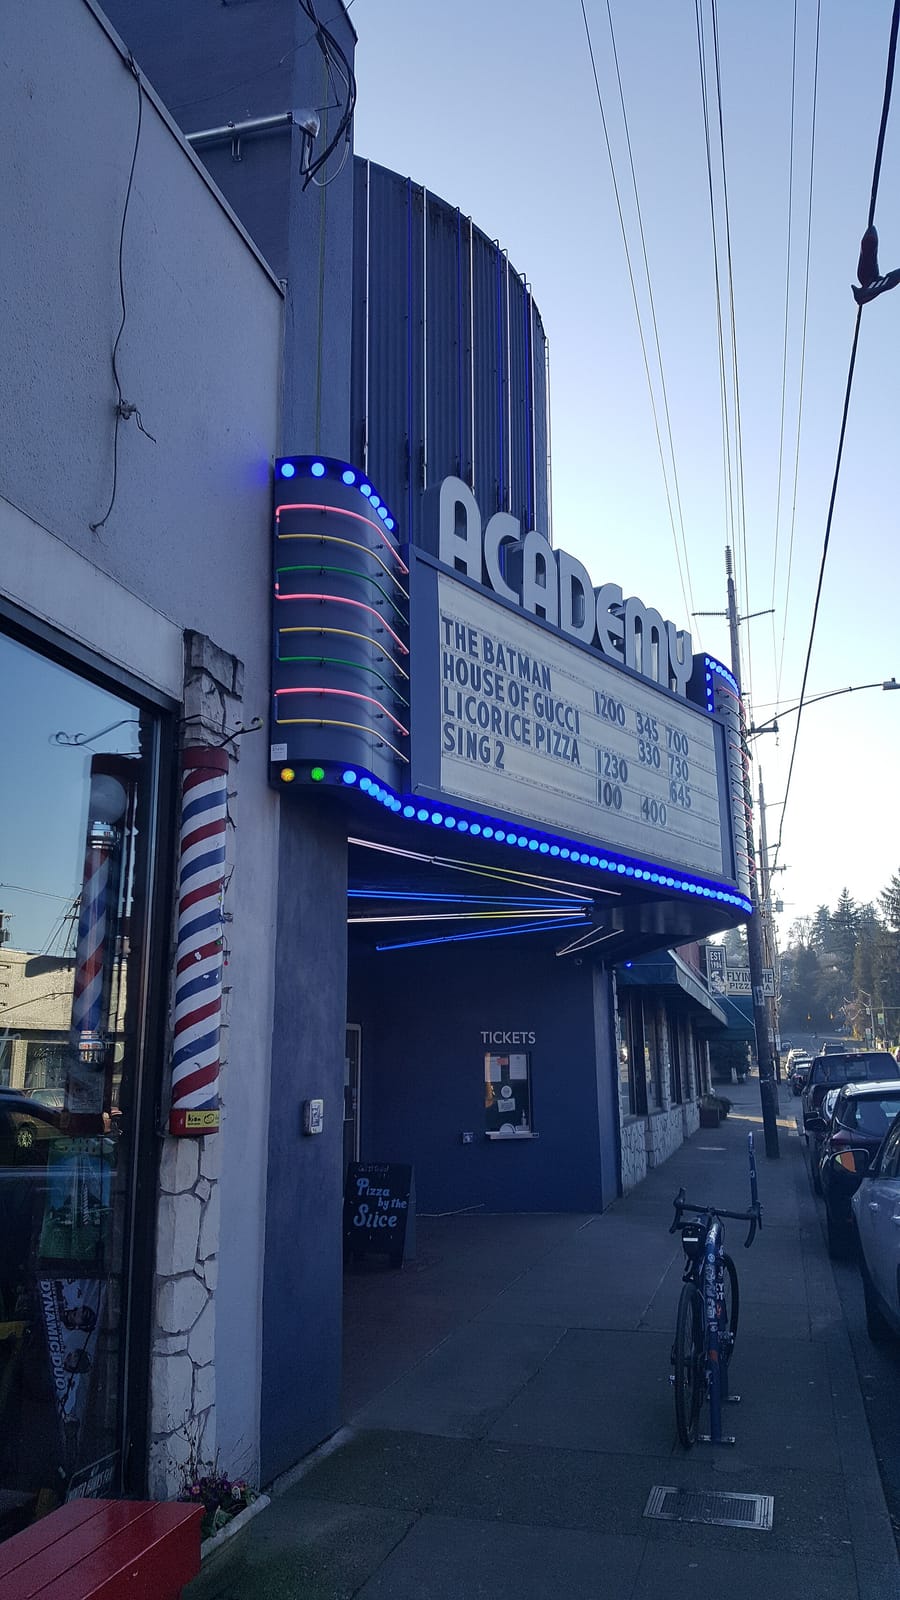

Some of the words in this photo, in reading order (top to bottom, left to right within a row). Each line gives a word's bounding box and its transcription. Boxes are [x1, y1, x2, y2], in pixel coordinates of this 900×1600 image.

[441, 615, 479, 659] THE
[482, 636, 552, 692] BATMAN
[594, 690, 626, 727] 1200
[636, 711, 659, 743] 345
[666, 727, 689, 757] 700
[442, 651, 505, 703] HOUSE
[508, 680, 530, 712] OF
[533, 692, 581, 735] GUCCI
[638, 739, 661, 769] 330
[668, 754, 689, 782] 730
[443, 686, 531, 746] LICORICE
[535, 723, 581, 765] PIZZA
[597, 749, 628, 783] 1230
[669, 781, 692, 809] 645
[443, 721, 491, 764] SING
[495, 740, 505, 770] 2
[597, 779, 623, 810] 100
[641, 797, 667, 827] 400
[710, 951, 721, 961] EST
[727, 971, 752, 982] FLYIN
[480, 1031, 536, 1044] TICKETS
[357, 1177, 390, 1196] Pizza
[353, 1203, 398, 1228] Slice
[378, 1197, 390, 1211] by
[391, 1198, 408, 1209] the
[40, 1280, 60, 1354] DYNAMIC
[50, 1354, 67, 1392] DUO
